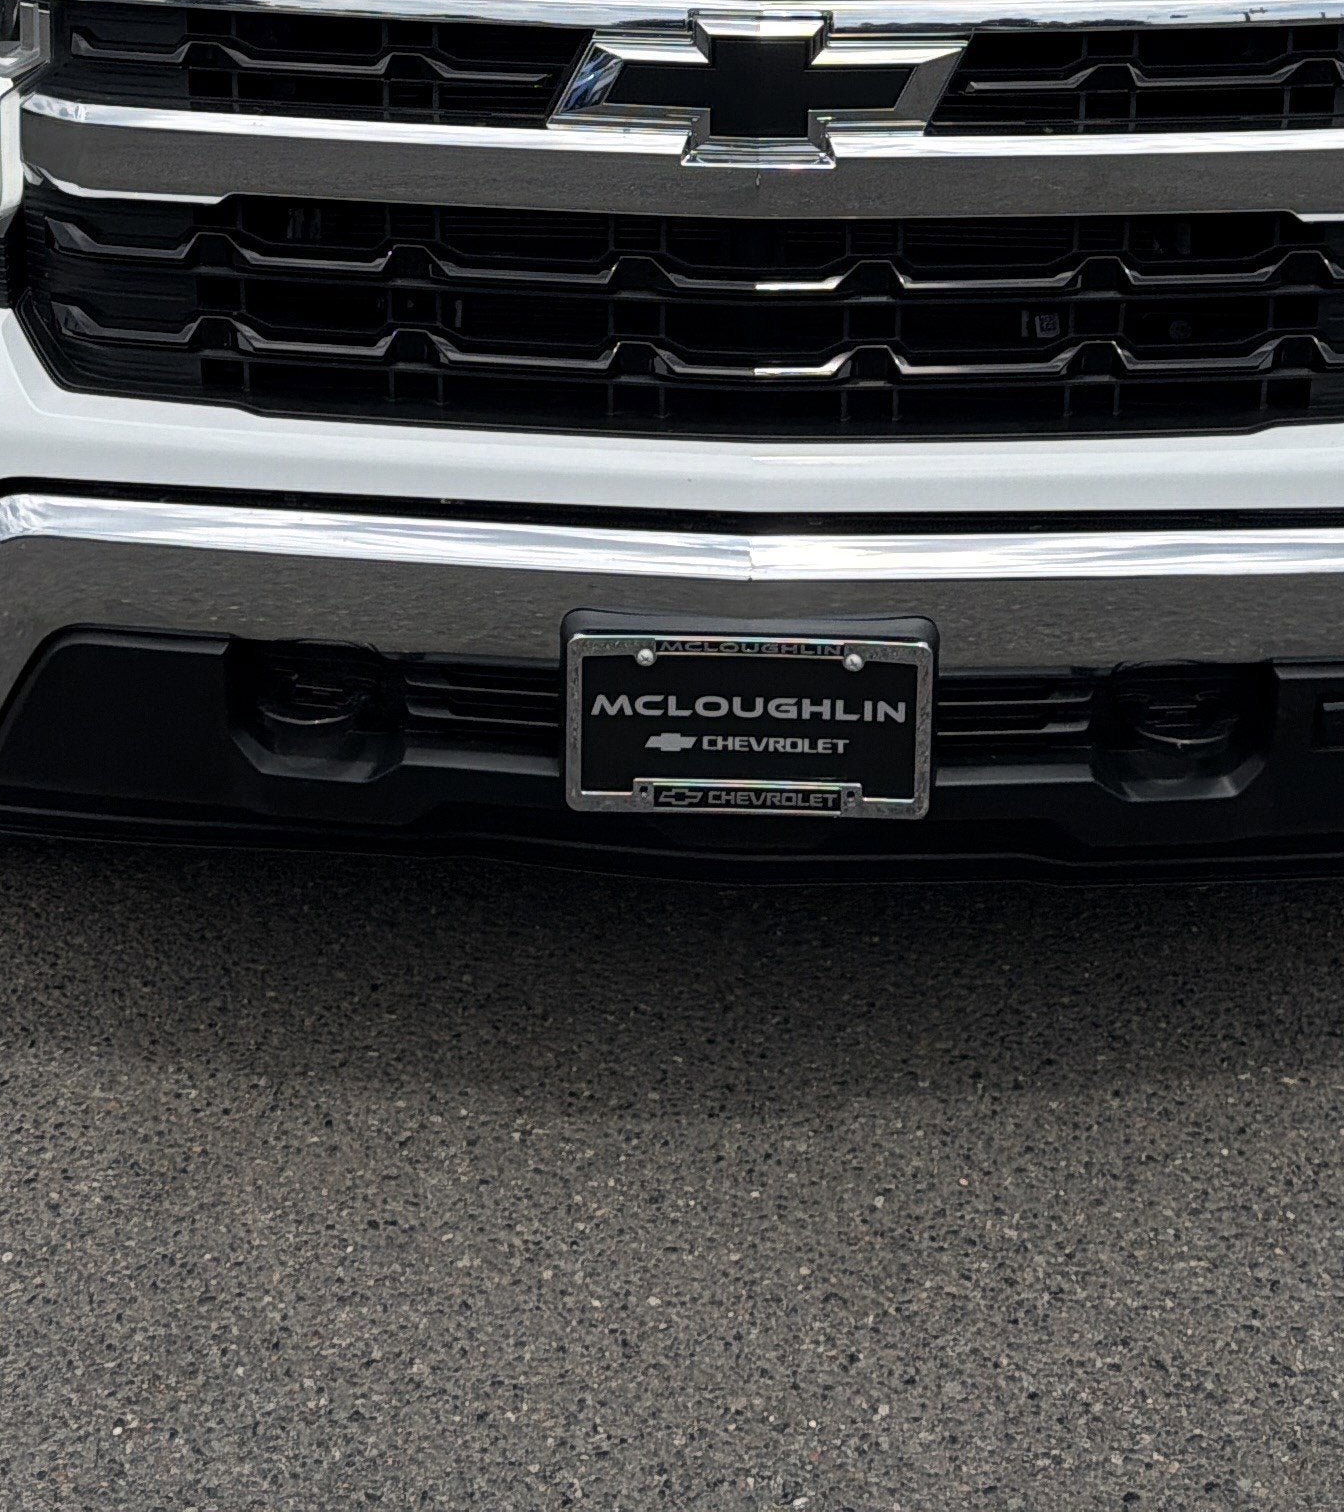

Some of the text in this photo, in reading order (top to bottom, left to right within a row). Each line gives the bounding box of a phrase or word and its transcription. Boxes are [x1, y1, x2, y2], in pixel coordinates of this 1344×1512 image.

[659, 640, 843, 657] MCLOUGHLIN
[590, 693, 907, 724] MCLOUGHLIN
[701, 734, 850, 755] CHEVROLET
[707, 790, 839, 808] CHEVROLET
